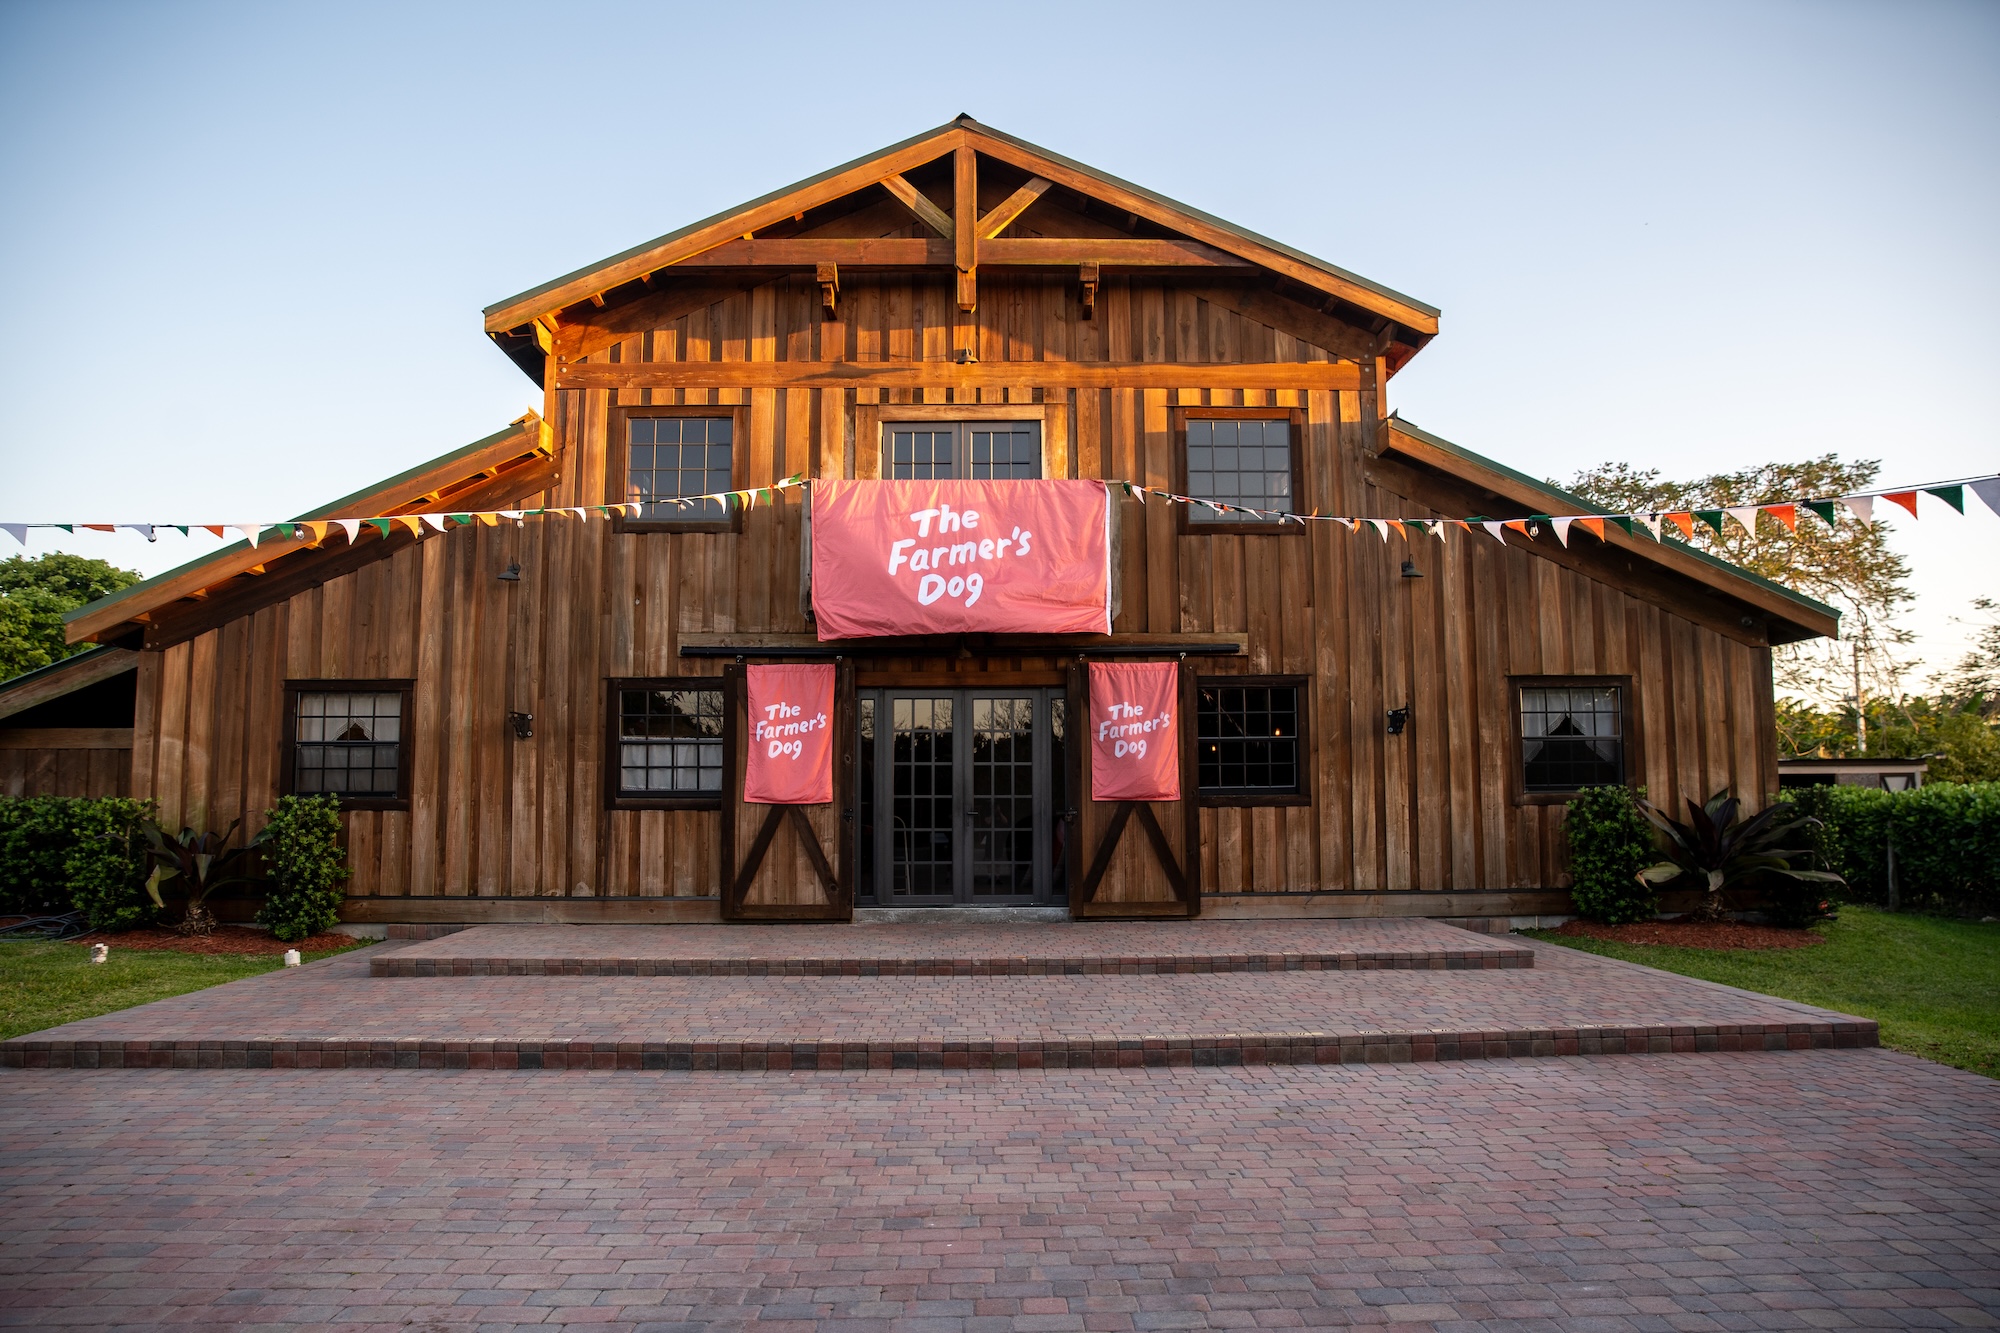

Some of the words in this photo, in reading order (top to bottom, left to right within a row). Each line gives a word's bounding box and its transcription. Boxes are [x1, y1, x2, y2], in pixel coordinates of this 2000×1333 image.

[910, 504, 980, 538] The
[887, 526, 1032, 576] Farmer's
[918, 573, 984, 608] Dog
[764, 702, 801, 720] The
[1108, 702, 1144, 720] The
[756, 712, 827, 742] Farmer's
[1099, 711, 1170, 742] Farmer's
[767, 740, 803, 760] Dog
[1114, 740, 1147, 760] Dog
